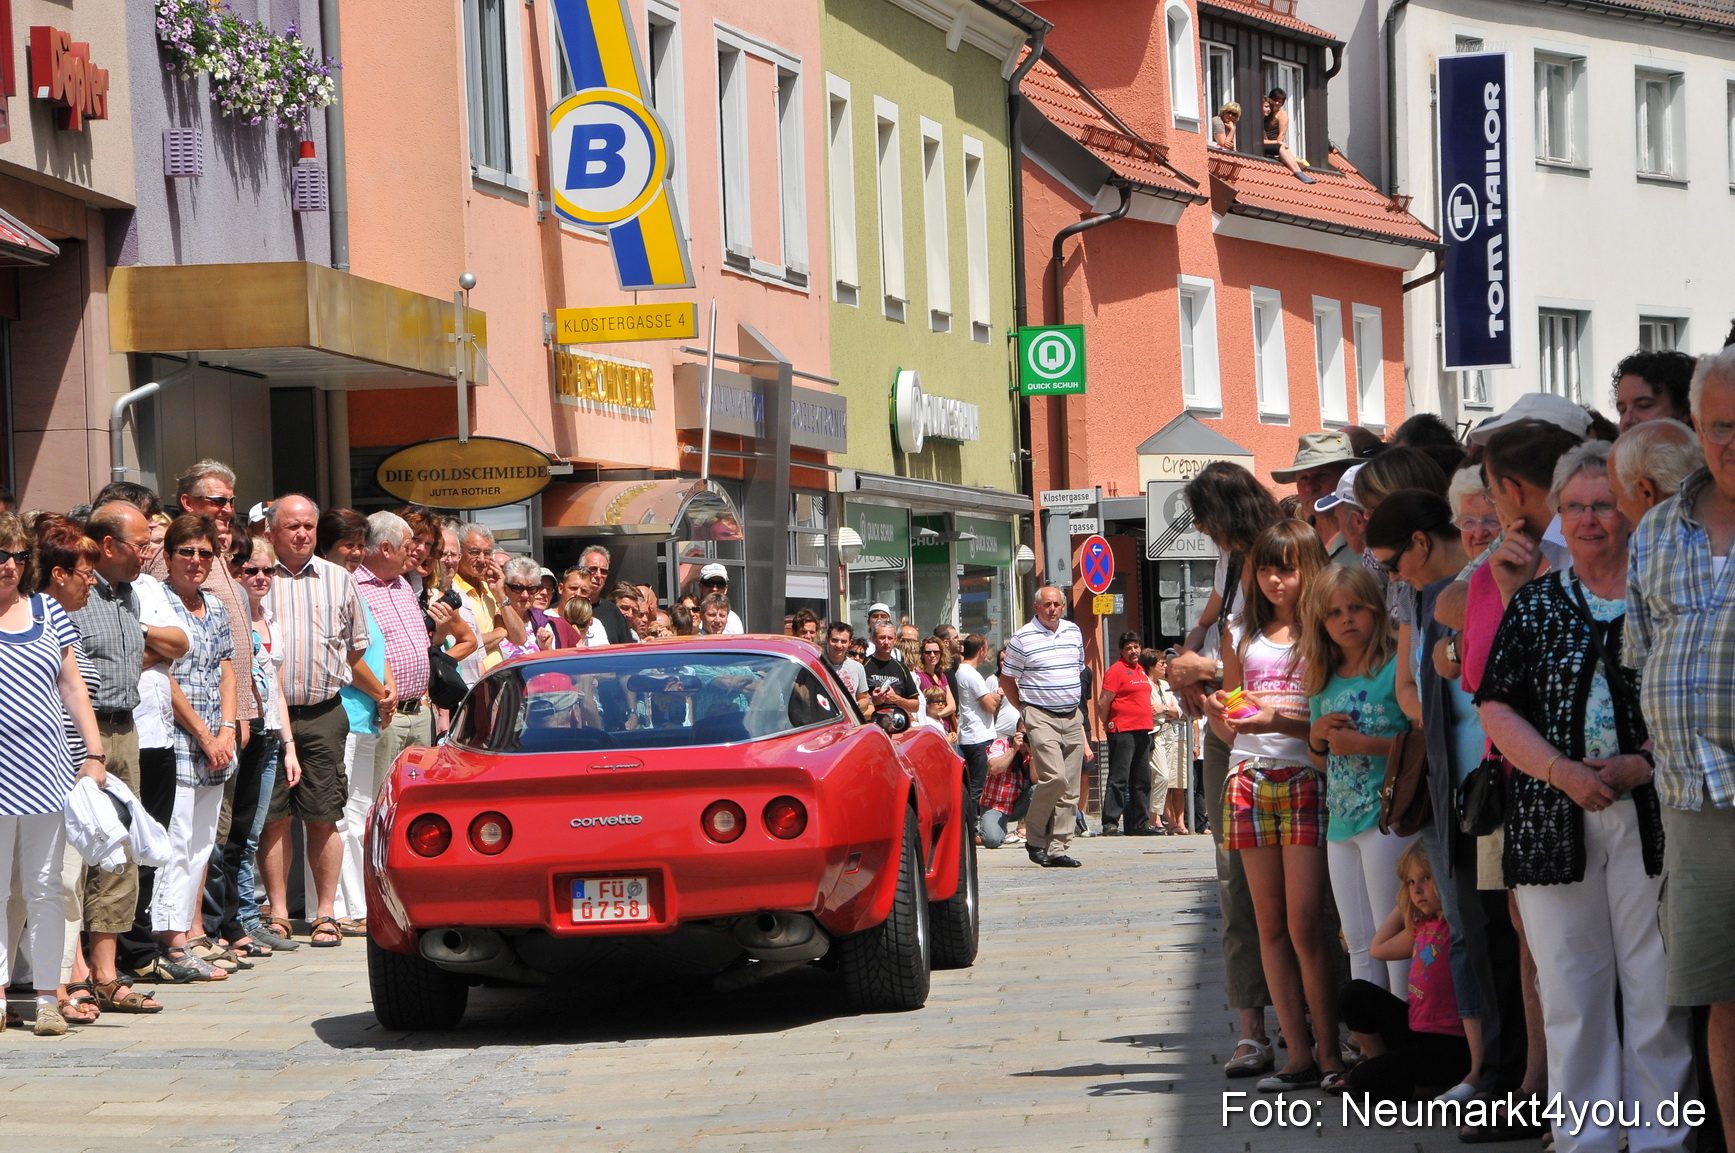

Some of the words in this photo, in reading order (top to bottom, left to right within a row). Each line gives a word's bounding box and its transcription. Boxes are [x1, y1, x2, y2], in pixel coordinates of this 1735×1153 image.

[46, 26, 109, 131] Döpfer
[565, 122, 627, 191] B
[1484, 81, 1502, 227] TAILOR
[1487, 233, 1504, 338] TOM
[564, 313, 672, 333] KLOSTERGASSE
[678, 313, 686, 327] 4
[1027, 382, 1051, 391] QUICK
[1053, 381, 1079, 389] SCHUH
[385, 469, 413, 483] DIE
[417, 465, 548, 482] GOLDSCHMIEDE
[430, 488, 459, 497] JUTTA
[461, 487, 501, 496] ROTHER
[1043, 492, 1090, 503] Klostergasse
[867, 521, 880, 543] QUICK
[879, 523, 894, 542] SCHUH
[1069, 522, 1094, 533] rgasse
[1168, 538, 1206, 551] ZONE
[570, 814, 643, 828] corvette
[599, 881, 624, 899] FÜ
